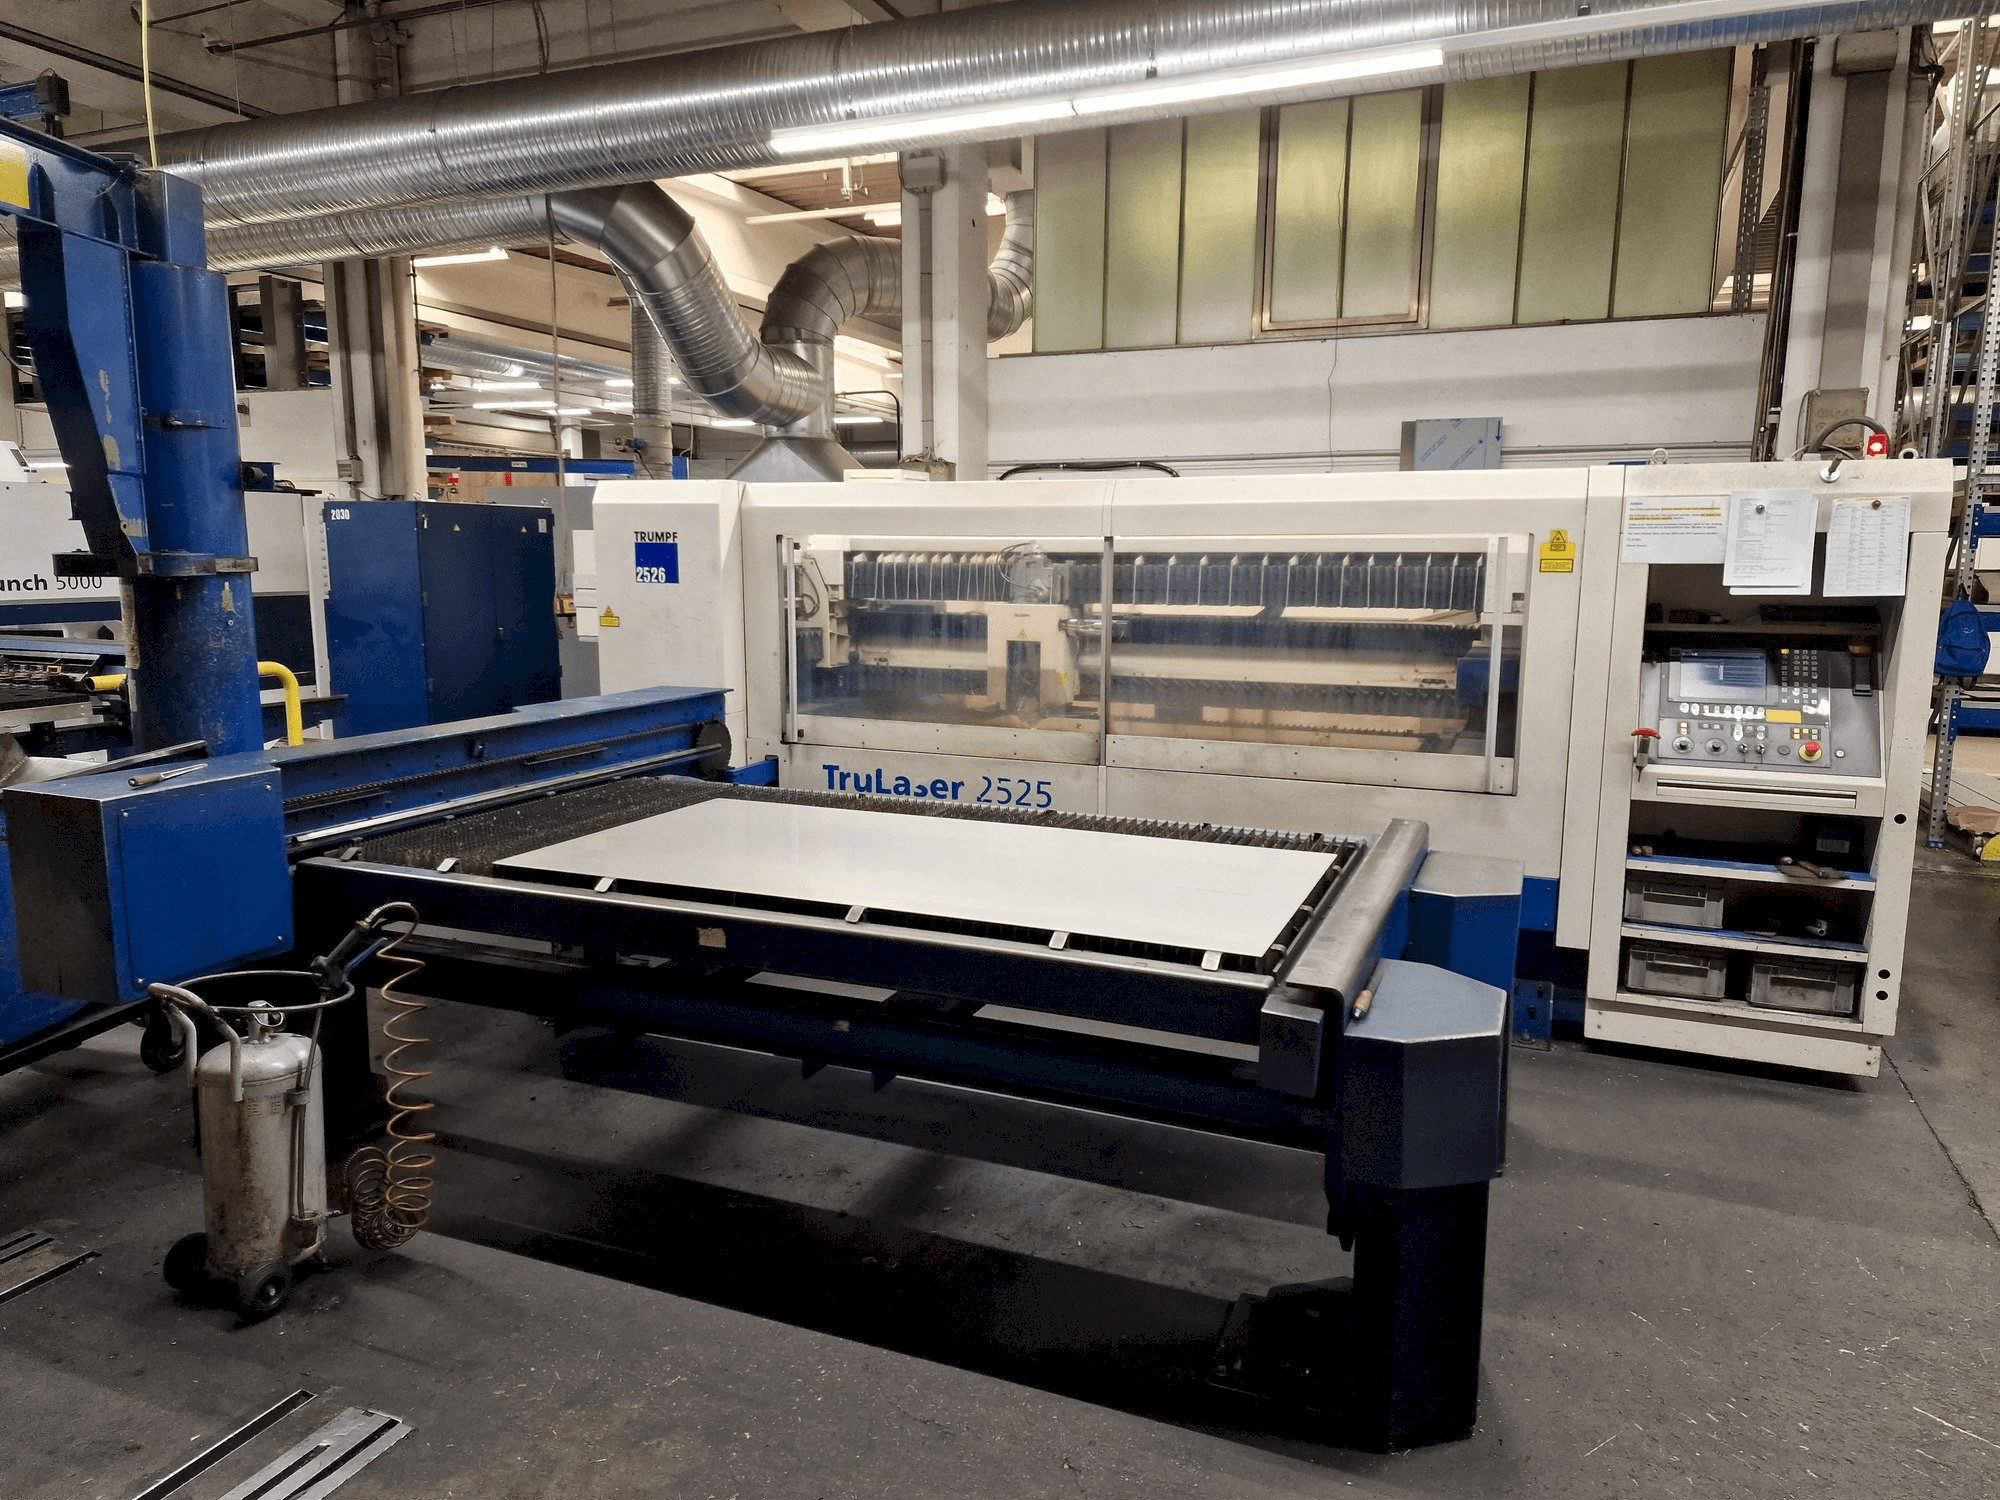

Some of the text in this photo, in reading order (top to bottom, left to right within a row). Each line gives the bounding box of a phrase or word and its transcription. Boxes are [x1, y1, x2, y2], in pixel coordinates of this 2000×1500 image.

[331, 508, 350, 520] 2030
[634, 531, 678, 542] TRUMPF
[636, 566, 666, 583] 2526
[56, 576, 102, 590] 5000
[822, 764, 1052, 808] TruLaser 2525
